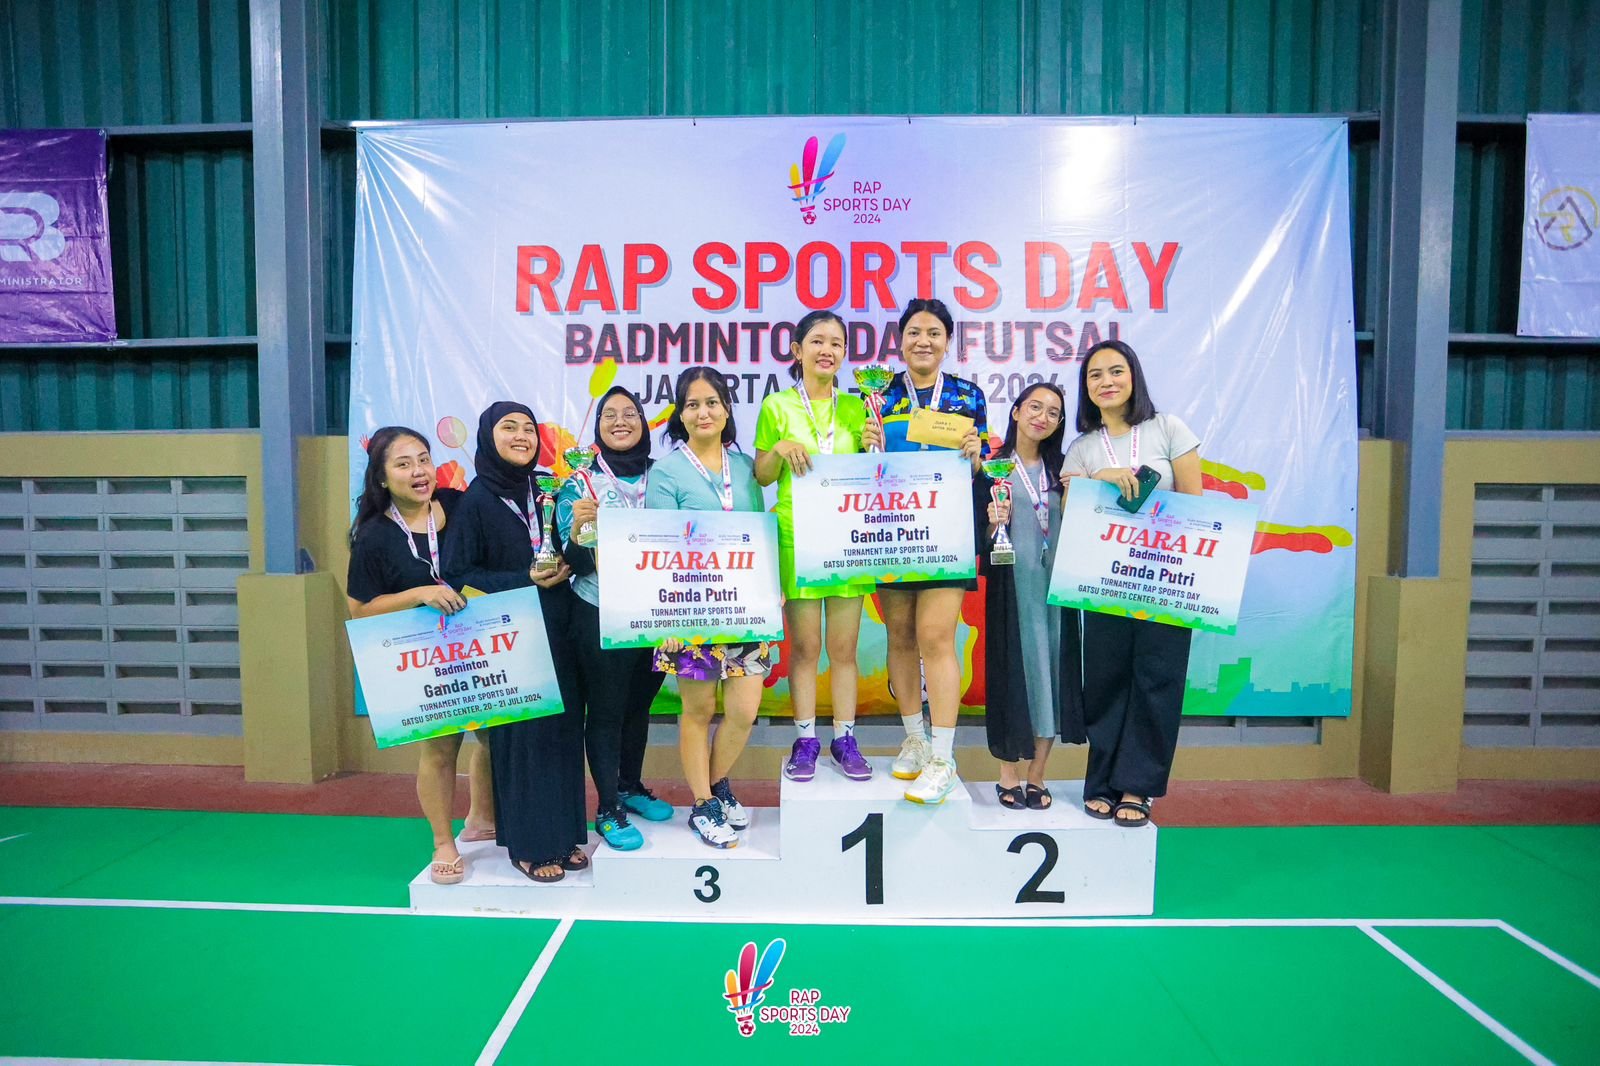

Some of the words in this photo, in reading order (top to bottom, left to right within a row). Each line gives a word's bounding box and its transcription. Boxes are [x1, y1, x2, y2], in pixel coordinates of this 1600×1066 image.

[854, 182, 881, 194] RAP
[824, 198, 878, 211] SPORTS
[883, 199, 911, 211] DAY
[854, 214, 880, 224] 2024
[515, 243, 670, 313] RAP
[692, 241, 1000, 313] SPORTS
[1024, 241, 1180, 313] DAY
[565, 321, 795, 364] BADMINTO
[848, 321, 905, 363] DA
[838, 491, 923, 512] JUARA
[928, 491, 938, 508] I
[864, 513, 915, 524] Badminton
[851, 529, 892, 543] Ganda
[897, 527, 929, 542] Putri
[1100, 523, 1187, 554] JUARA
[1193, 537, 1219, 558] II
[635, 551, 720, 570] JUARA
[726, 551, 755, 570] III
[843, 548, 882, 557] TURNAMENT
[900, 546, 924, 554] SPORTS
[1129, 548, 1182, 565] Badminton
[824, 560, 844, 568] GATSU
[847, 559, 872, 567] SPORTS
[1111, 560, 1154, 580] Ganda
[1159, 568, 1195, 587] Putri
[672, 572, 723, 582] Badminton
[659, 588, 701, 603] Ganda
[706, 587, 737, 602] Putri
[1101, 577, 1141, 591] TURNAMENT
[1142, 584, 1157, 593] RAP
[1158, 586, 1186, 598] SPORTS
[1187, 591, 1200, 601] DAY
[1078, 585, 1100, 595] GATSU
[1101, 588, 1127, 599] SPORTS
[1159, 598, 1168, 606] 20
[1174, 601, 1182, 609] 21
[1183, 602, 1200, 612] JULI
[1201, 605, 1219, 615] 2024
[651, 608, 691, 616] TURNAMENT
[735, 606, 746, 614] DAY
[631, 621, 652, 629] GATSU
[654, 620, 680, 628] SPORTS
[711, 618, 720, 626] 20
[750, 617, 765, 625] 2024
[397, 639, 485, 672] JUARA
[491, 631, 519, 654] IV
[435, 660, 488, 677] Badminton
[424, 678, 468, 698] Ganda
[472, 670, 507, 688] Putri
[420, 698, 460, 712] TURNAMENT
[463, 694, 477, 704] RAP
[479, 690, 504, 701] SPORTS
[506, 687, 518, 696] DAY
[402, 716, 424, 726] GATSU
[425, 711, 451, 723] SPORTS
[484, 702, 492, 711] 20
[499, 700, 506, 708] 21
[508, 696, 522, 706] JULI
[524, 694, 541, 703] 2024
[841, 813, 884, 904] 1
[1006, 832, 1066, 904] 2
[694, 865, 721, 903] 3
